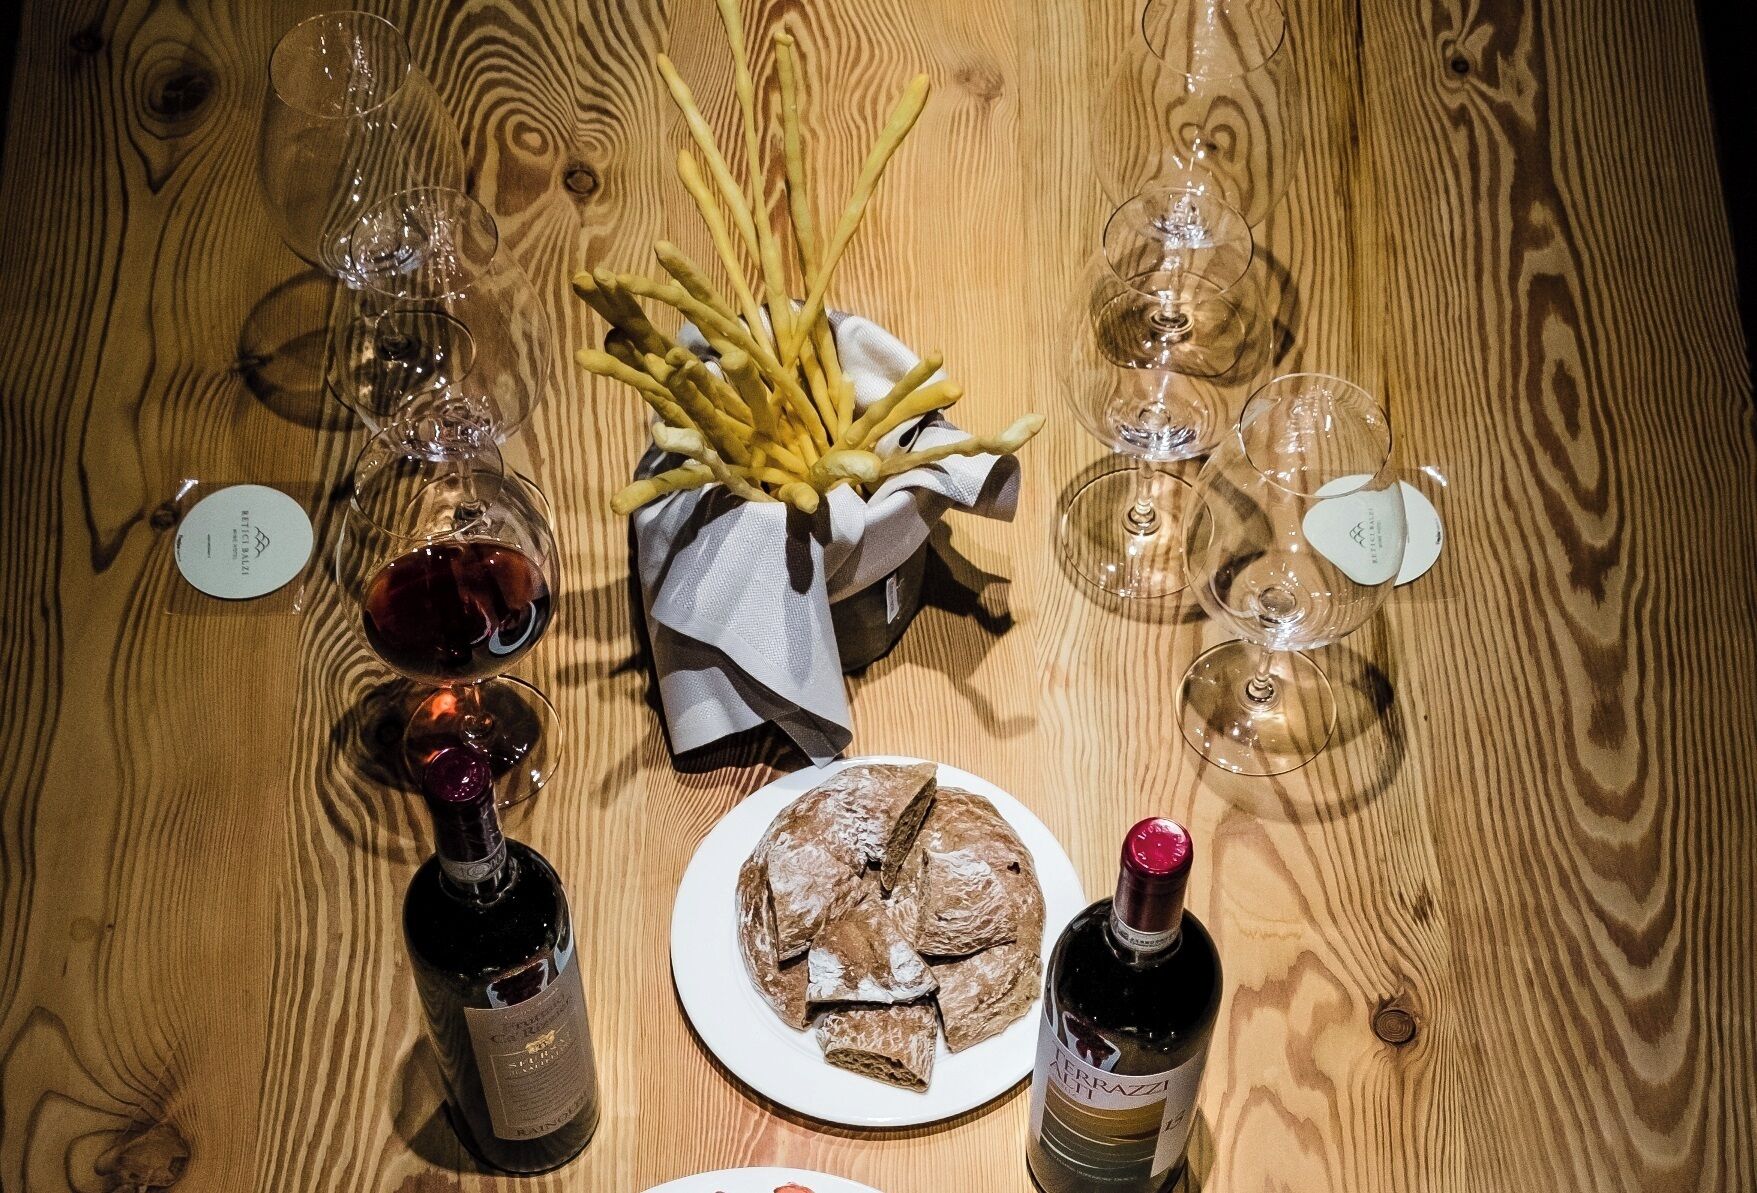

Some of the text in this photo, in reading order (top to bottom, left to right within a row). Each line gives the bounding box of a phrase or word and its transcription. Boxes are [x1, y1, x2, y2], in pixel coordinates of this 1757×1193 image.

[241, 510, 249, 575] RETICI BALZI
[1050, 1060, 1094, 1100] ALTI
[1051, 1040, 1169, 1097] TERRAZZI
